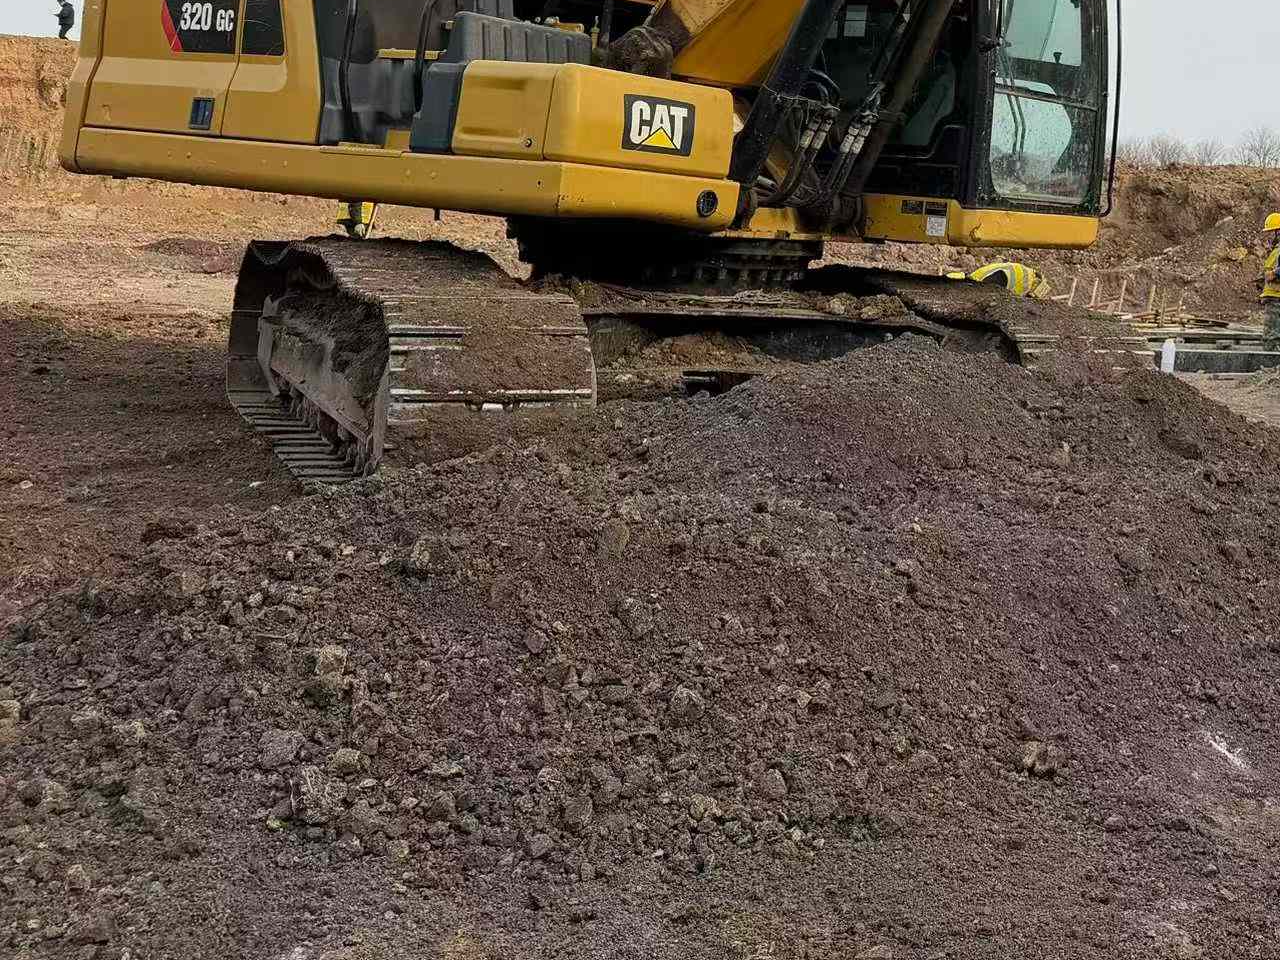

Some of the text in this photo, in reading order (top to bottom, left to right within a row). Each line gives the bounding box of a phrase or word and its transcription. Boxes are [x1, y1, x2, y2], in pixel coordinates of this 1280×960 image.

[179, 2, 235, 32] 320 GC
[629, 100, 689, 150] CAT
